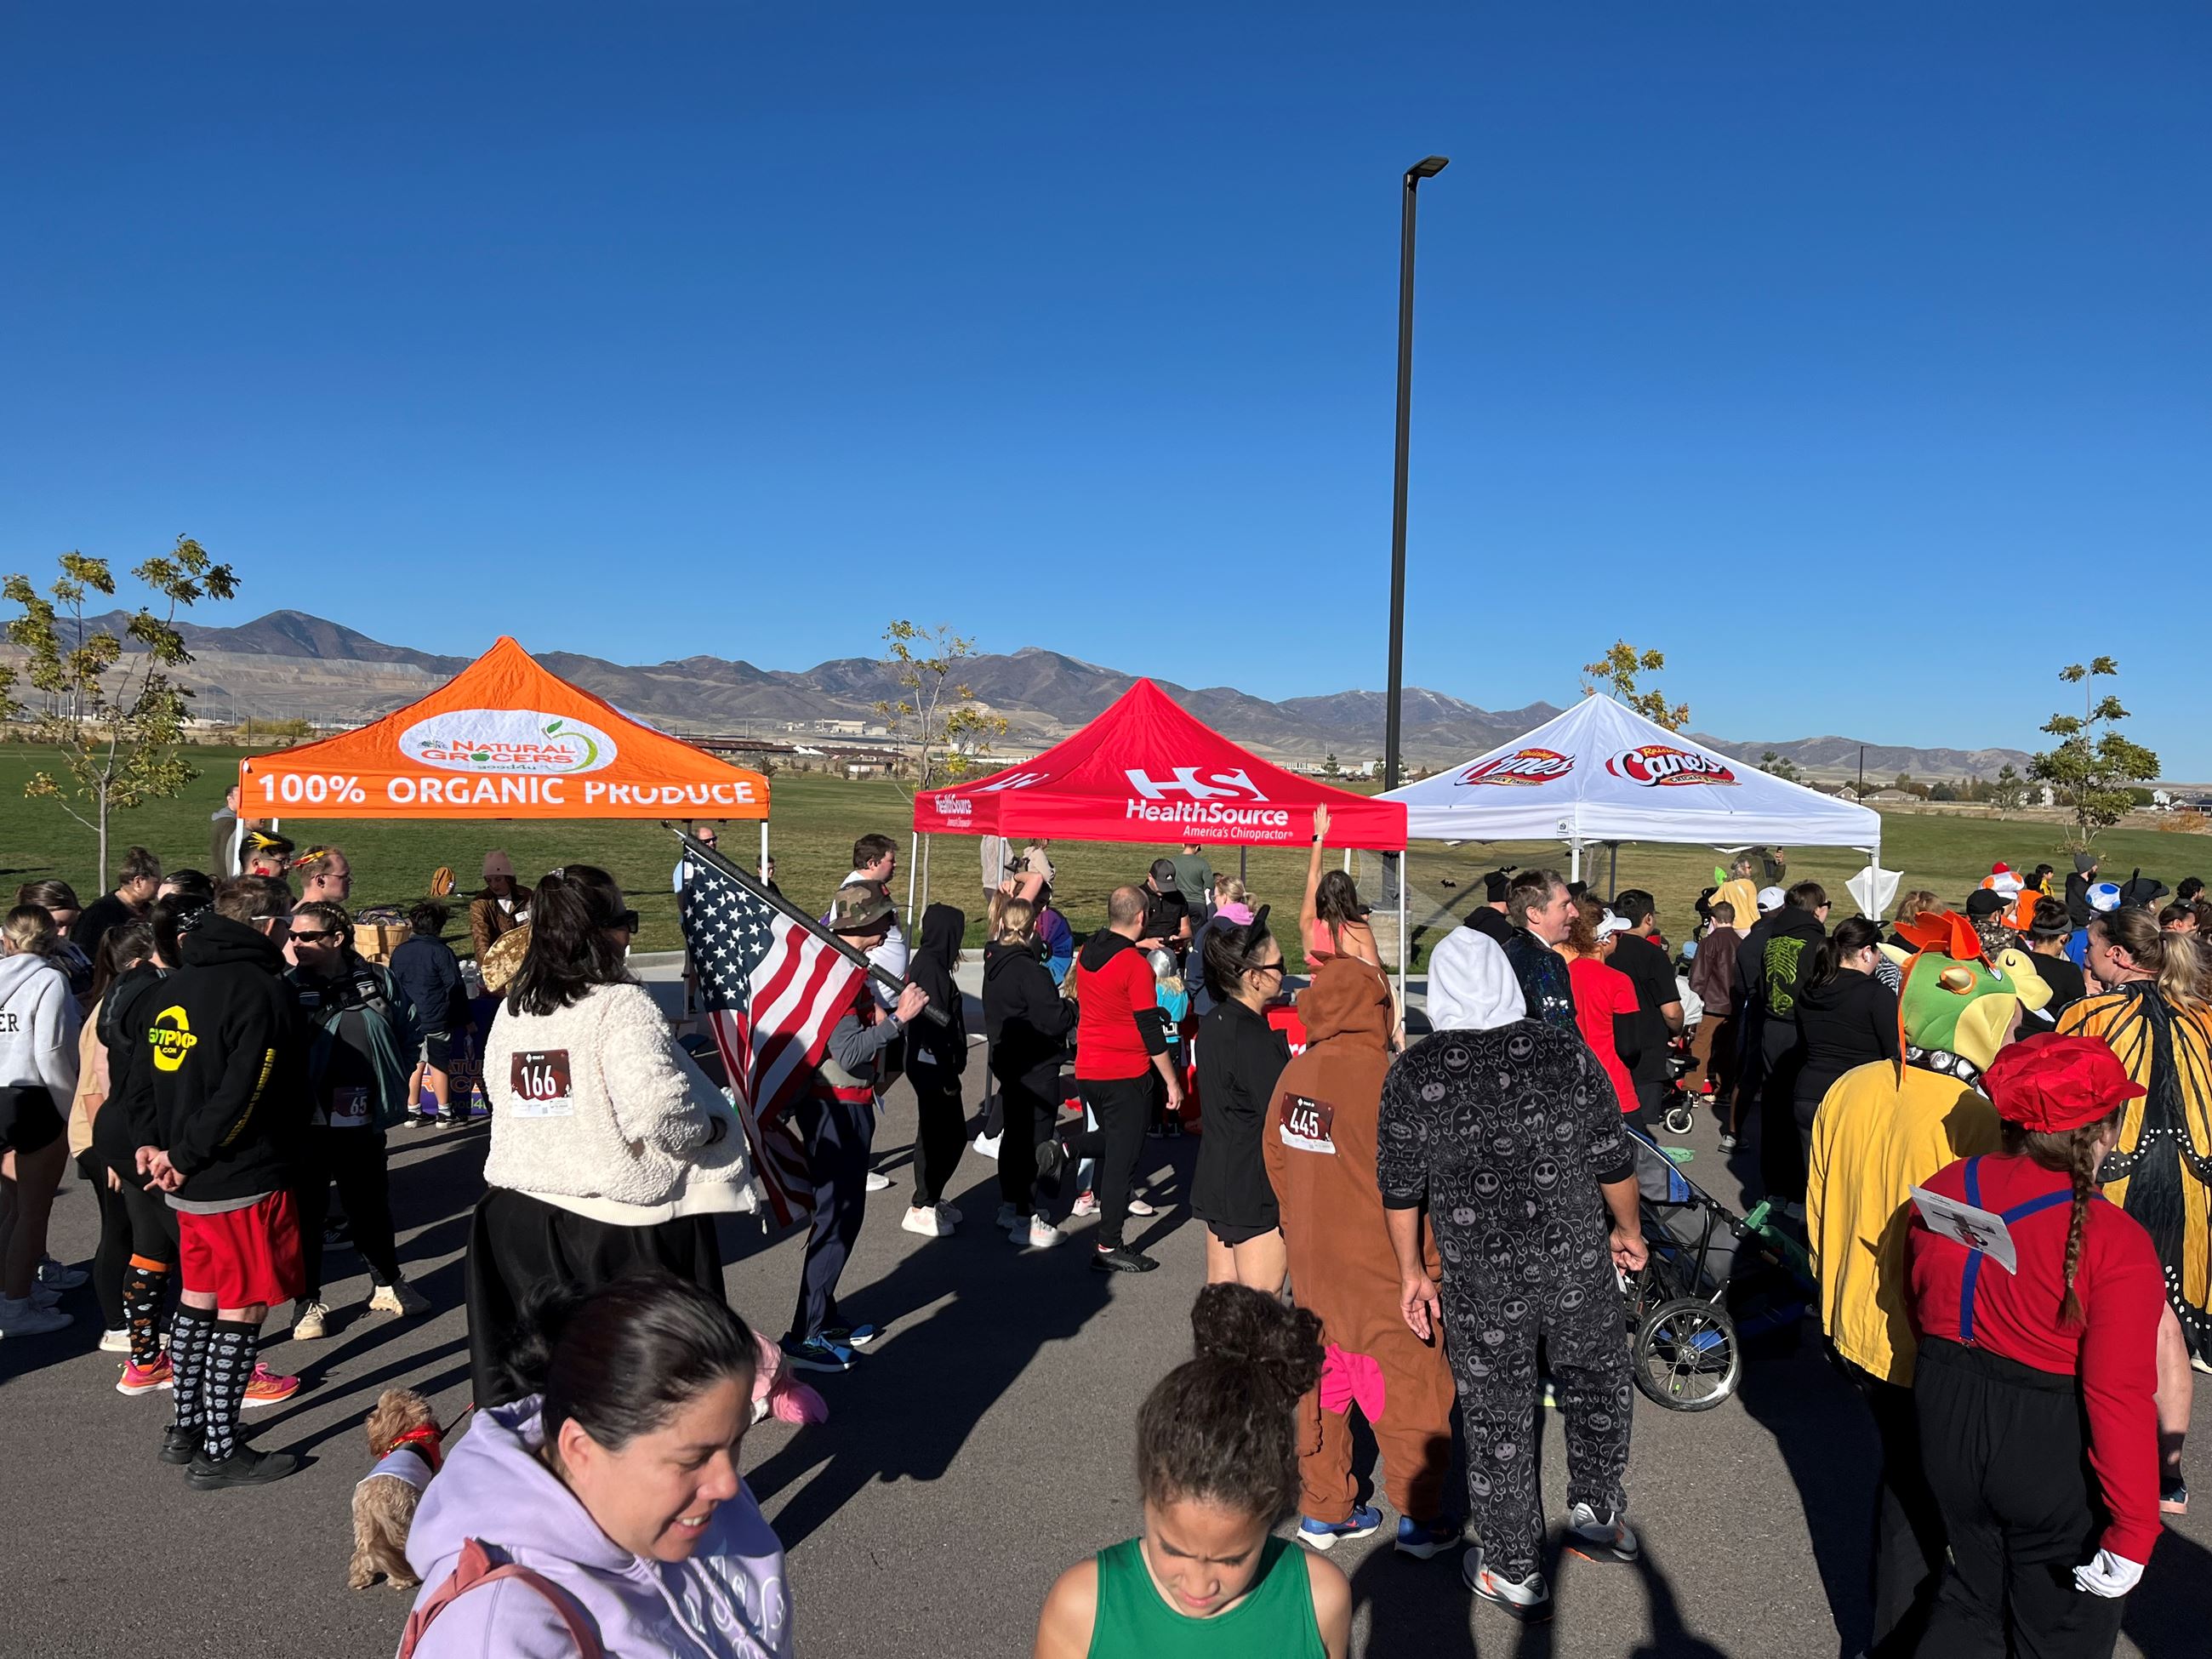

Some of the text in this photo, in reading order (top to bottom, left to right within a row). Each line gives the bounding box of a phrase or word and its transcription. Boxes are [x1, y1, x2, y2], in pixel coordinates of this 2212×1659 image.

[453, 739, 575, 754] NATURAL
[258, 773, 756, 804] 100% ORGANIC PRODUCE
[1125, 767, 1270, 802] HS
[1126, 798, 1289, 826] HealthSource
[1183, 824, 1228, 838] America's
[521, 1064, 556, 1097] 166
[1290, 1107, 1319, 1137] 445
